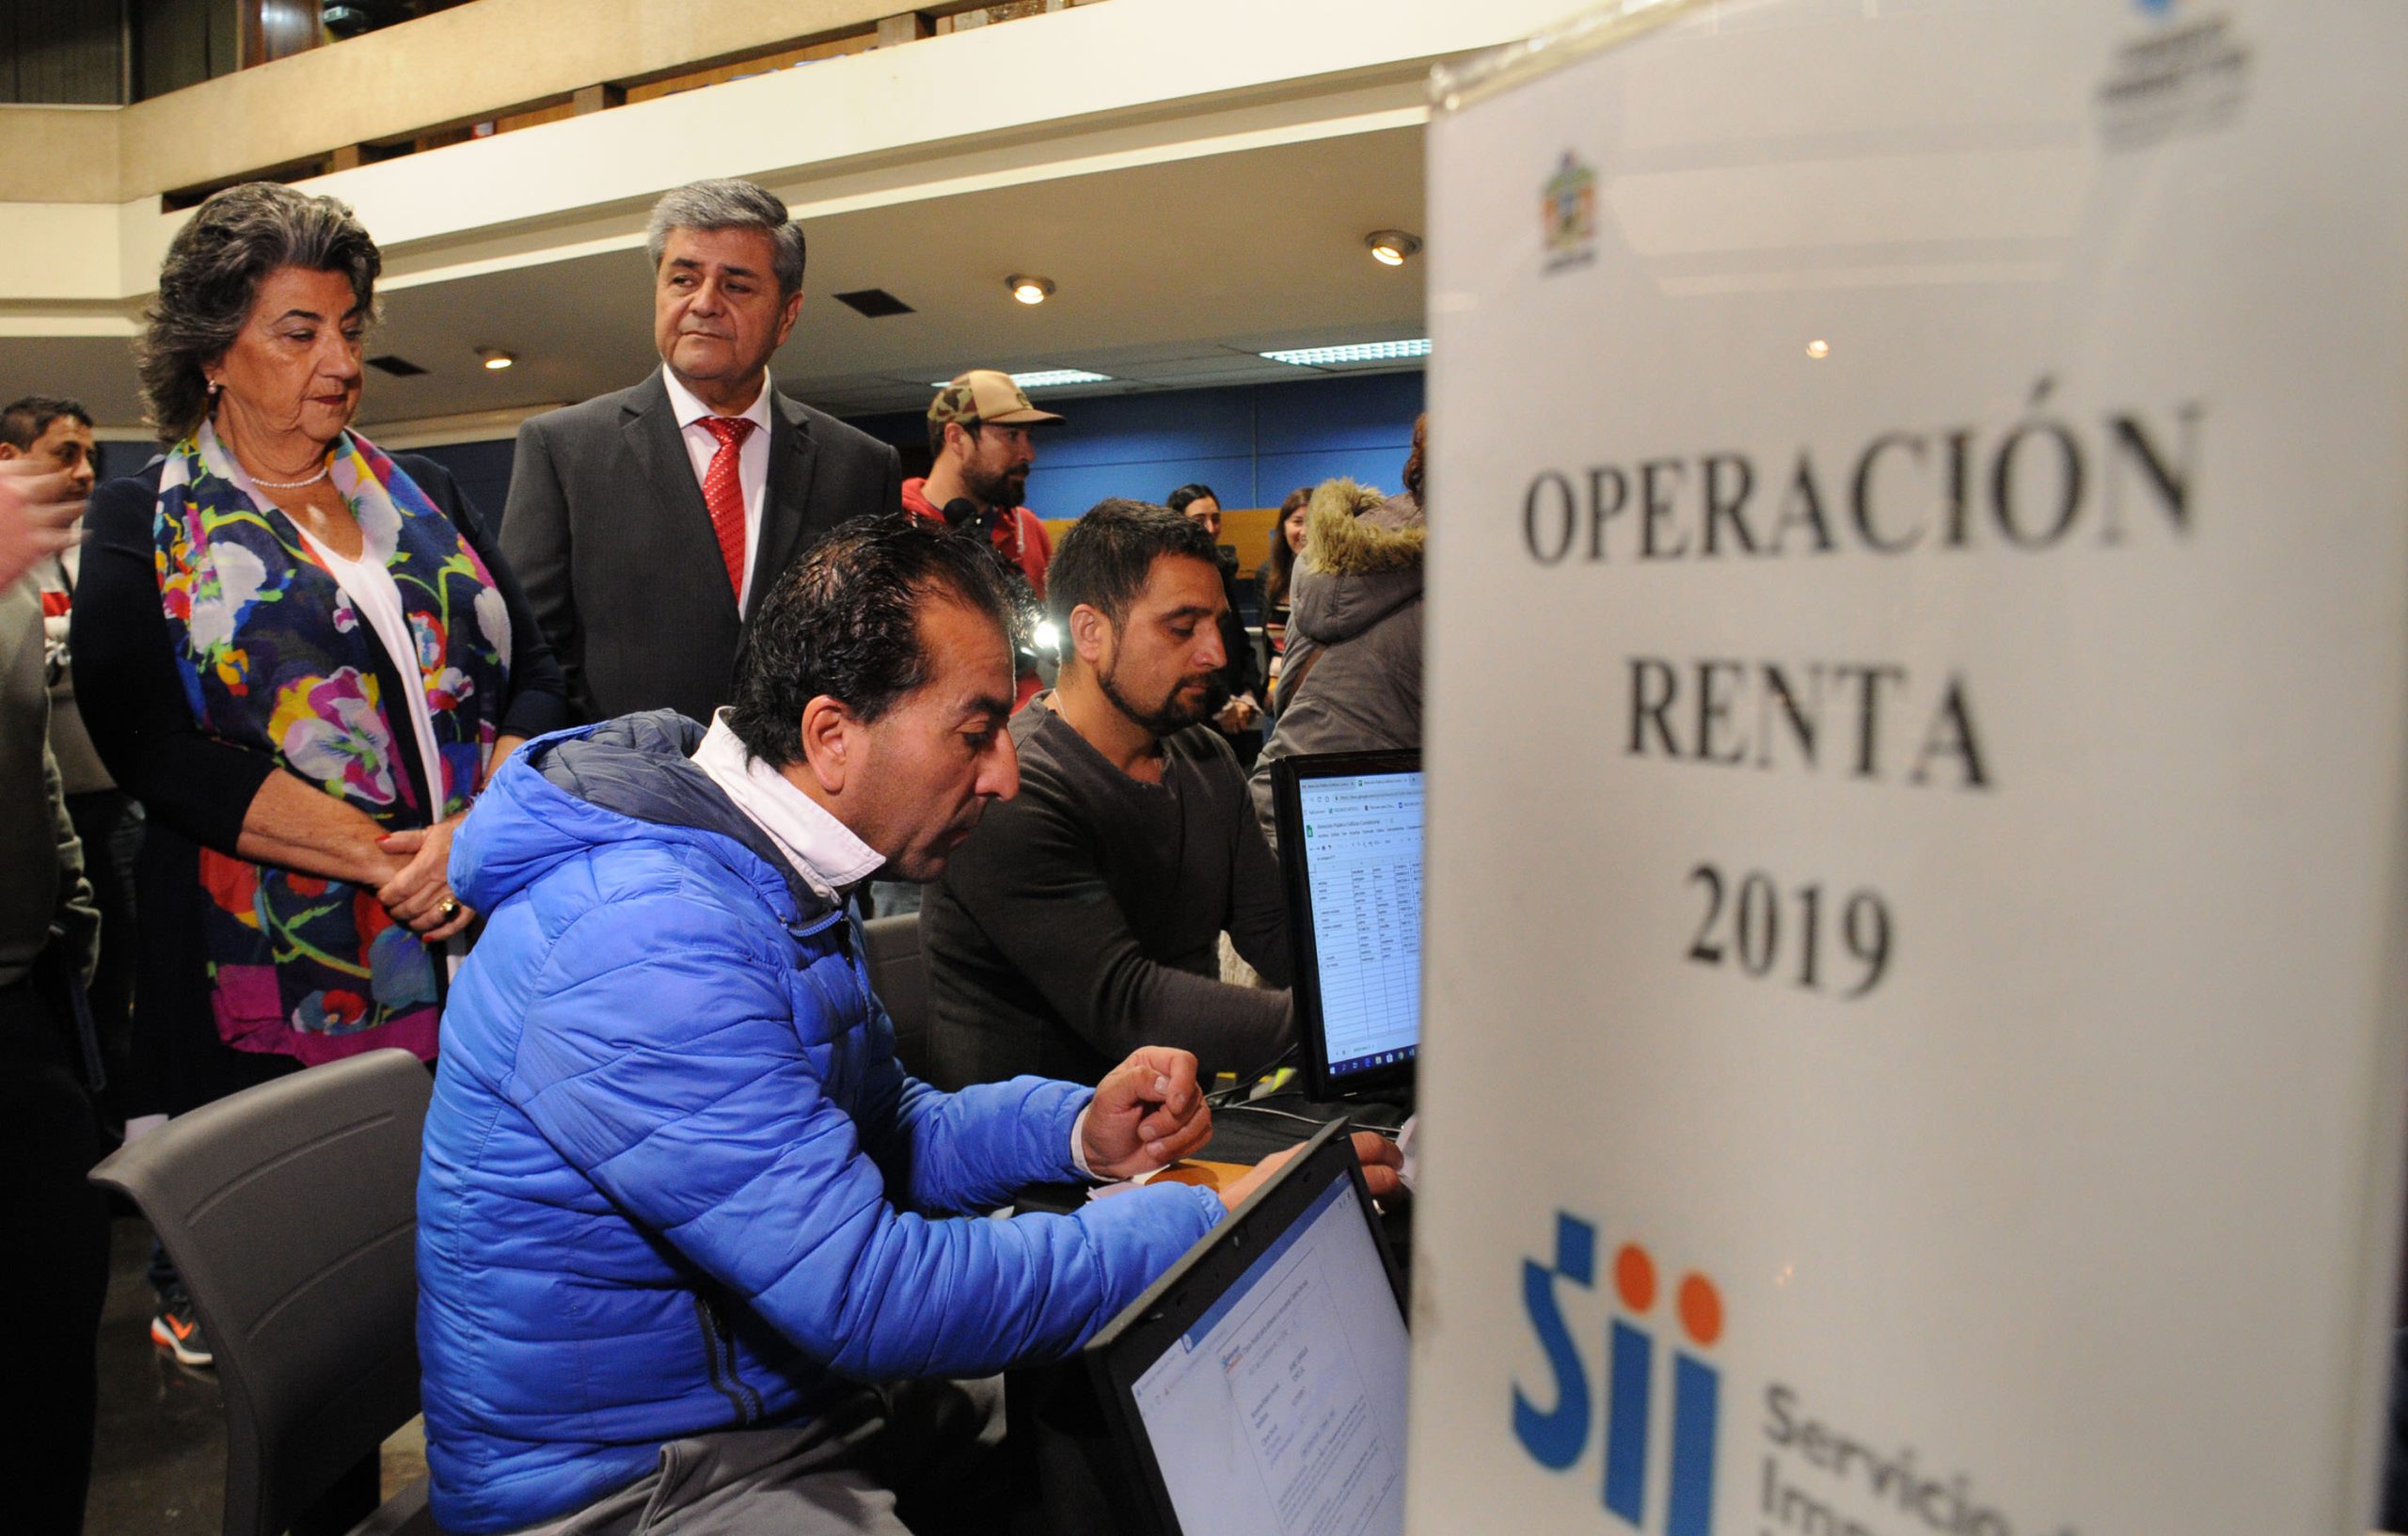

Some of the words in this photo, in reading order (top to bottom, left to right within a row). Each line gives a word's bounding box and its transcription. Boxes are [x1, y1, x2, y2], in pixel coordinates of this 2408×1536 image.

[1523, 374, 2203, 568] OPERACIÓN
[1624, 657, 1996, 792] RENTA
[1687, 861, 1894, 1001] 2019
